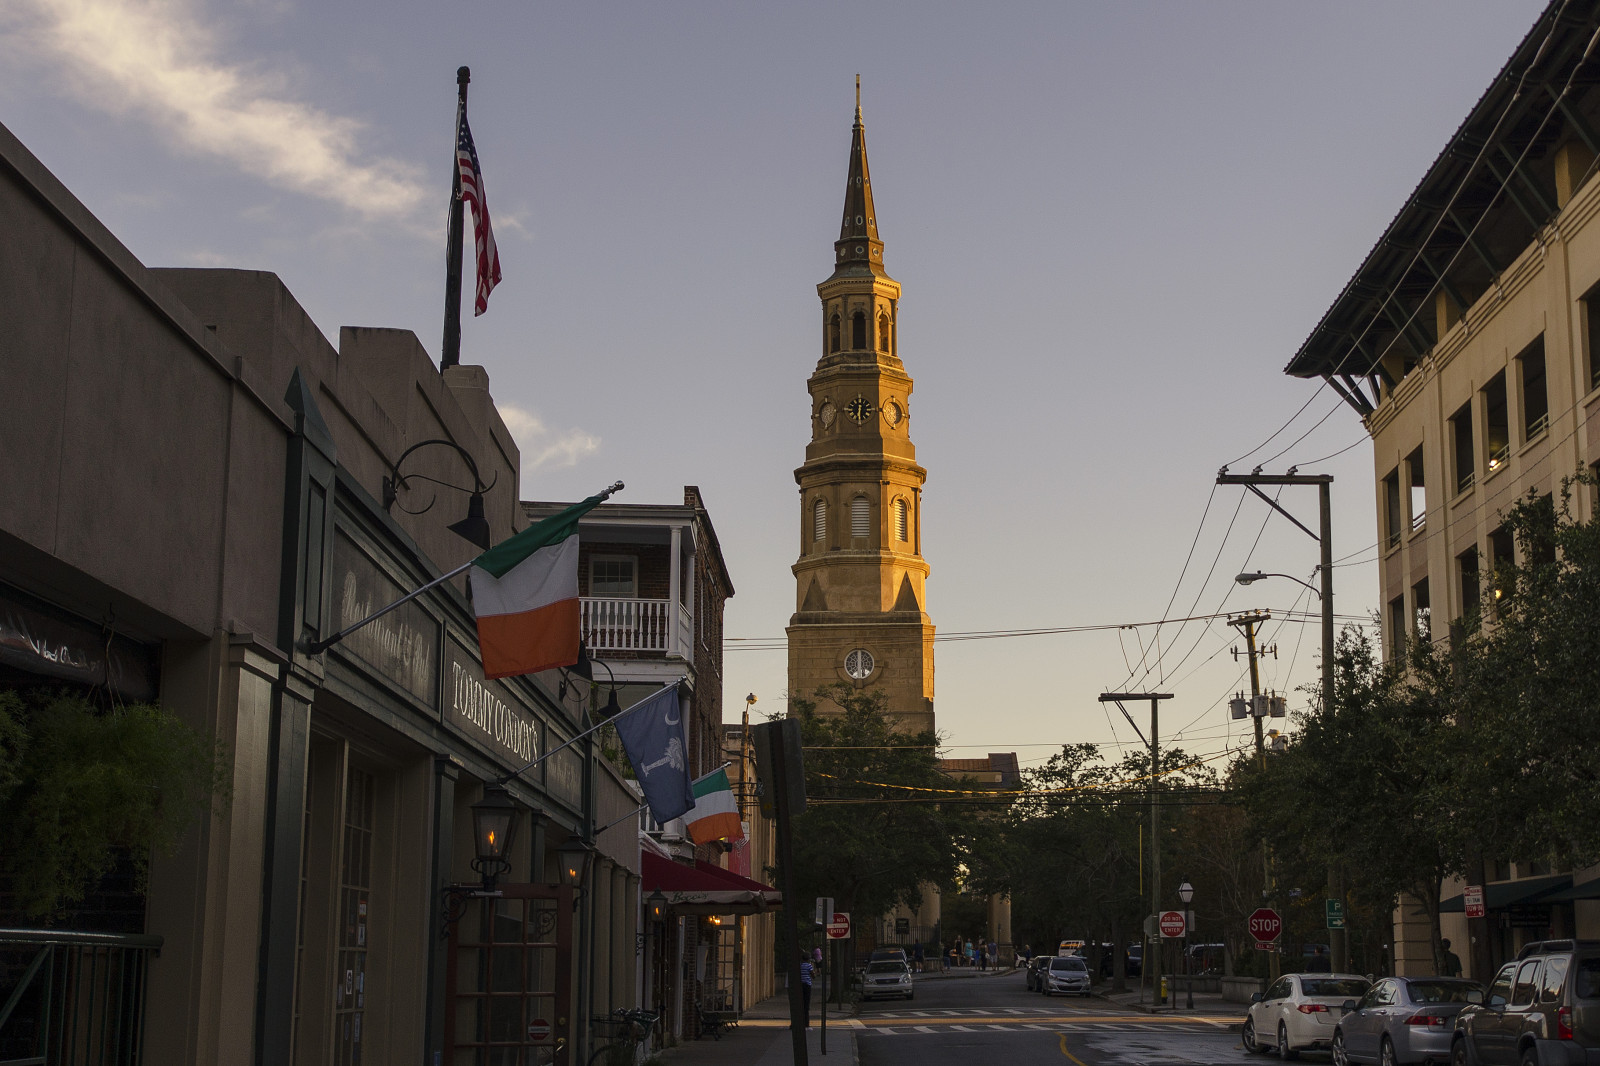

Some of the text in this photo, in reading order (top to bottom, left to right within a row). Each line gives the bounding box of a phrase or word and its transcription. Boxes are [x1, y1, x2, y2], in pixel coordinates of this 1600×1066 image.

[453, 661, 538, 768] TOMMY CONDON'S
[1334, 902, 1341, 911] P
[1251, 918, 1280, 932] STOP
